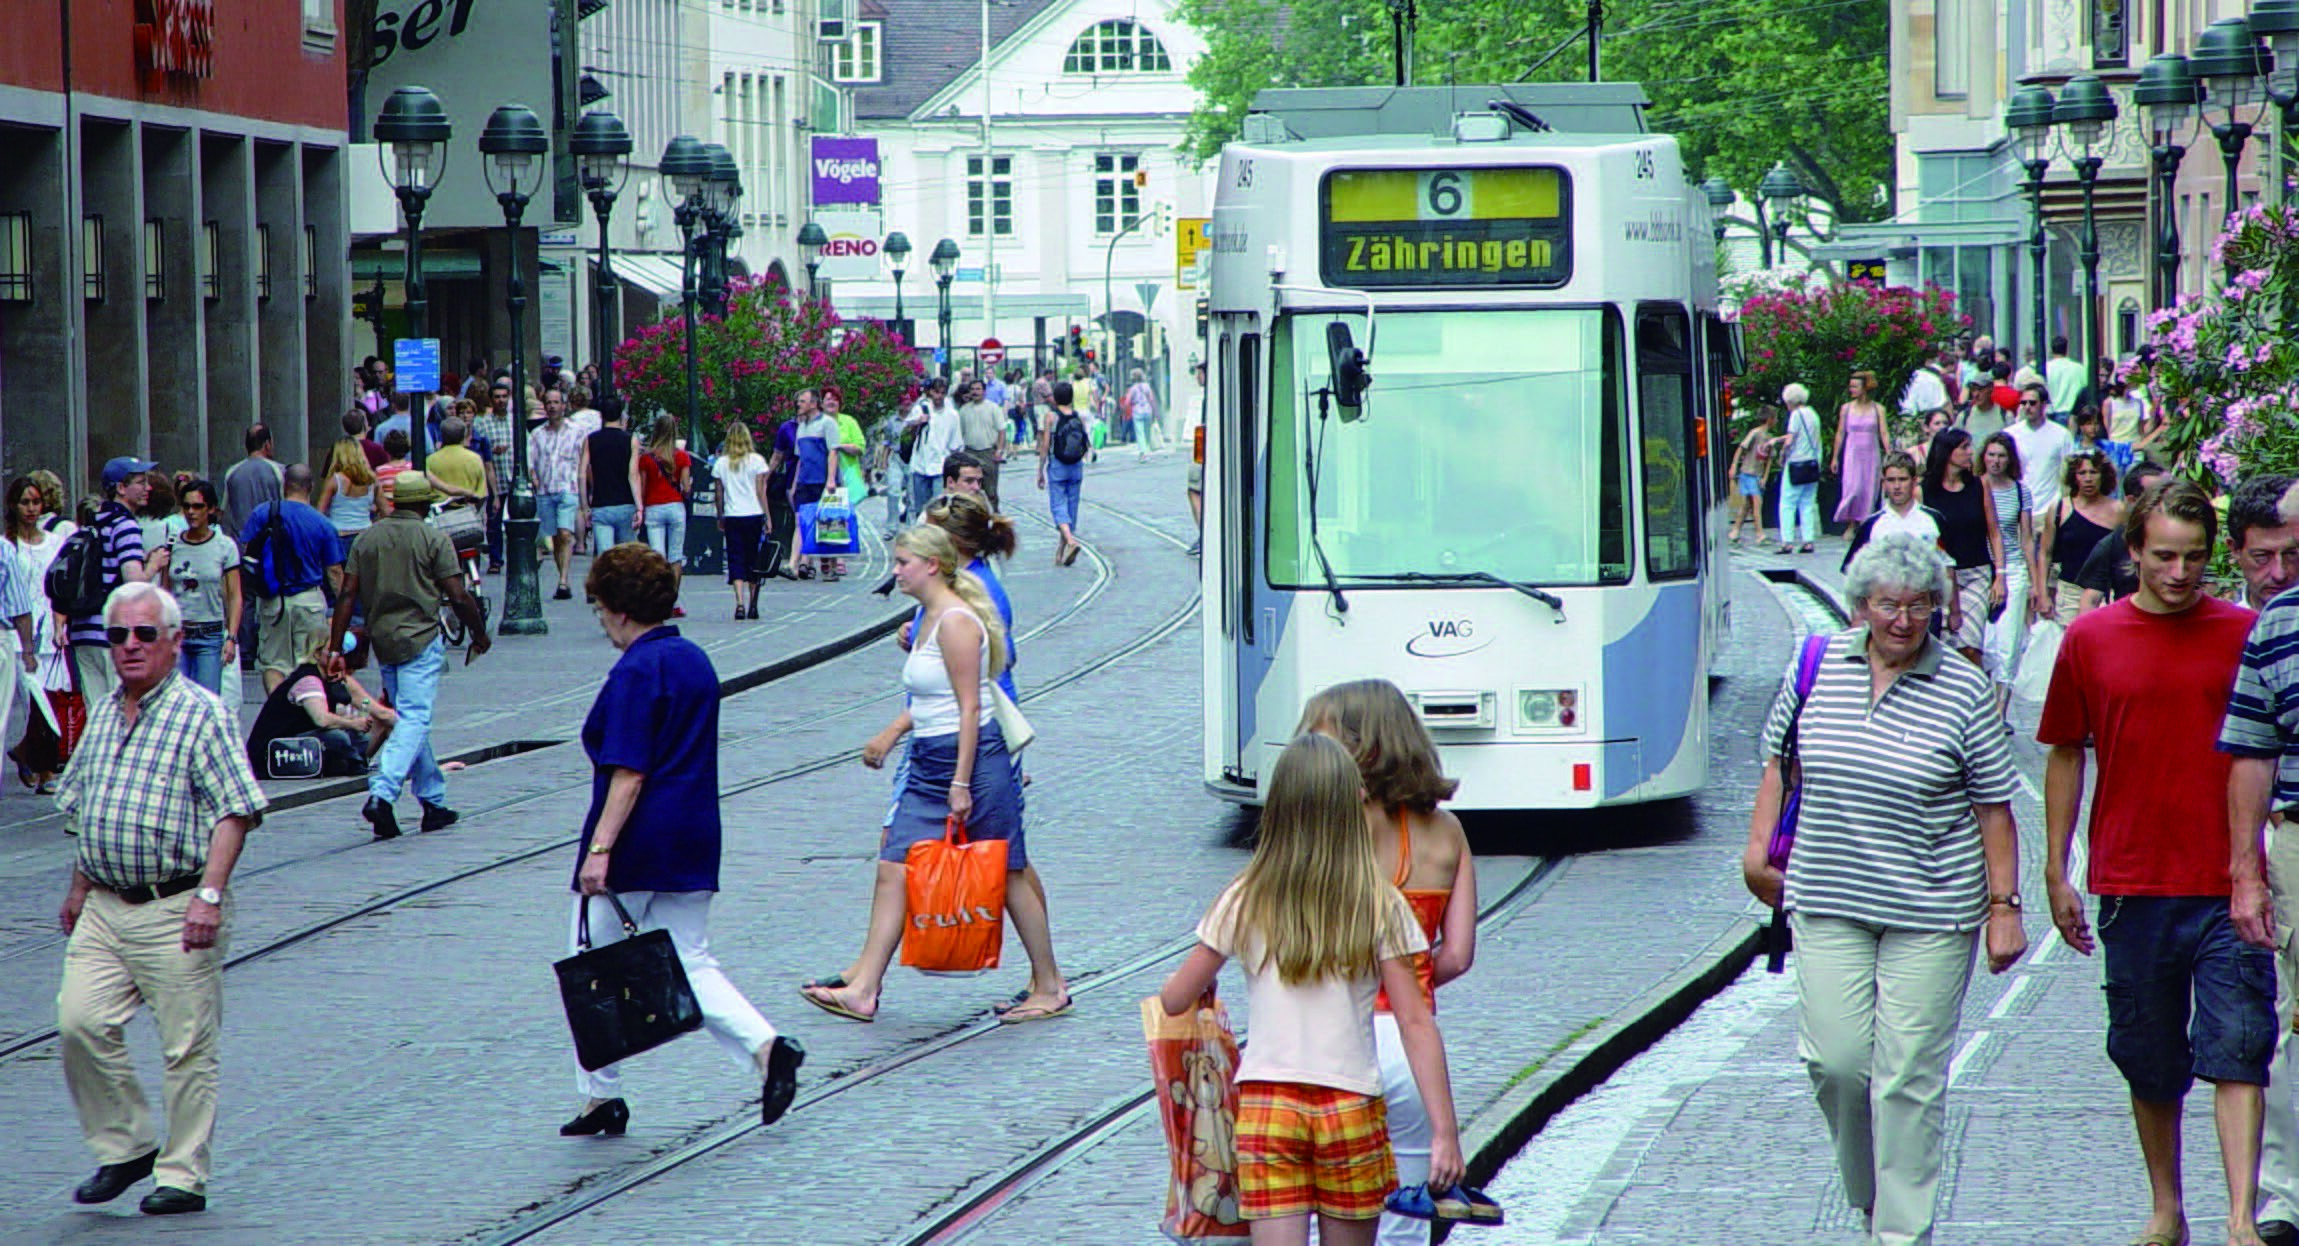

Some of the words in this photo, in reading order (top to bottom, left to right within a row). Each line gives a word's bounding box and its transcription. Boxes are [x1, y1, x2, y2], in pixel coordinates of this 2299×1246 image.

[815, 158, 878, 184] Vögele
[1237, 159, 1254, 188] 245
[1636, 150, 1654, 179] 245
[1429, 171, 1463, 216] 6
[819, 239, 878, 257] RENO
[1346, 235, 1552, 272] Zähringen
[1428, 619, 1473, 638] VAG
